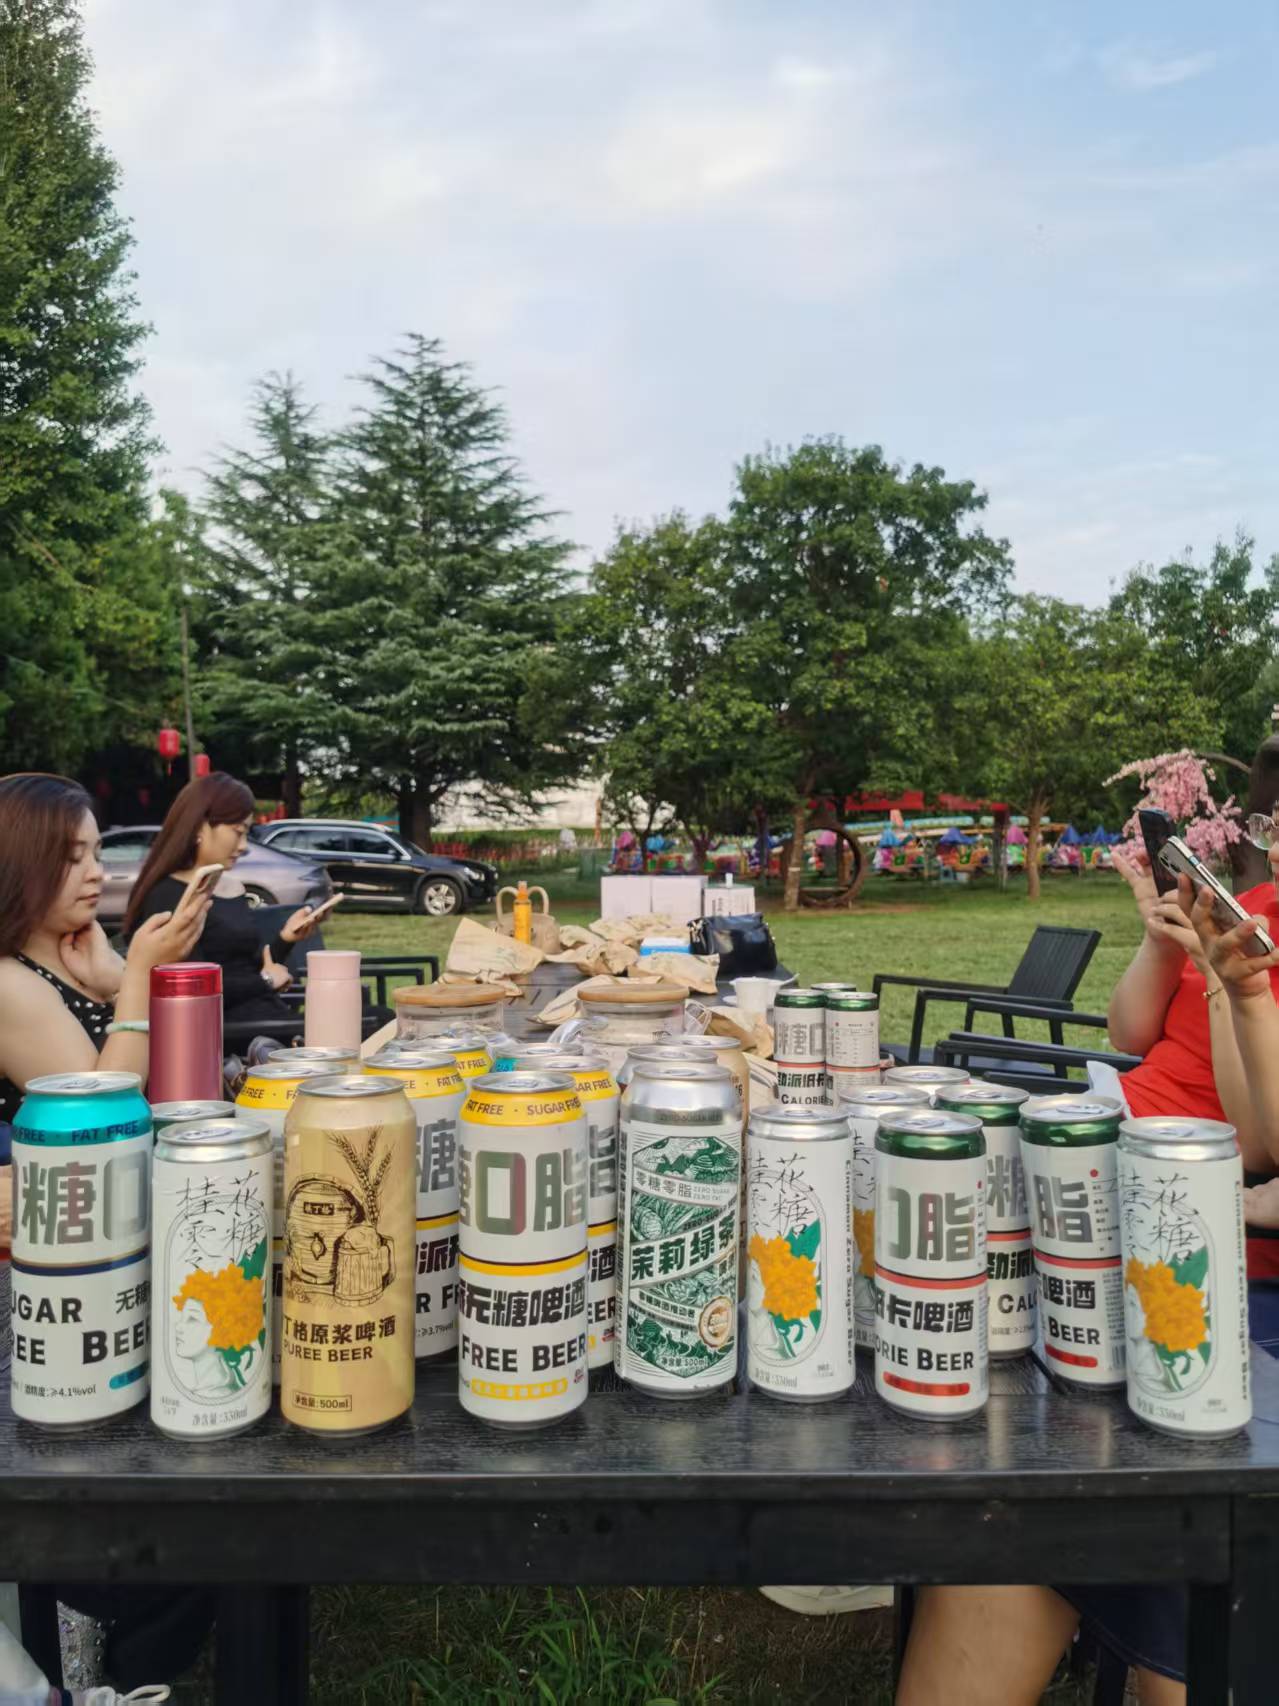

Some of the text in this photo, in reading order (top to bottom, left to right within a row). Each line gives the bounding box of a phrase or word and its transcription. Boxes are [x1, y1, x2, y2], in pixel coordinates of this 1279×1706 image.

[478, 1102, 504, 1116] FREE
[526, 1101, 567, 1116] SUGAR
[71, 1129, 99, 1142] FAT
[106, 1120, 139, 1137] FREE
[635, 1170, 693, 1200] 零糖零脂
[1047, 1315, 1101, 1345] BEER
[327, 1346, 374, 1363] BEER
[461, 1332, 586, 1373] FREE BEER
[917, 1347, 974, 1372] BEER
